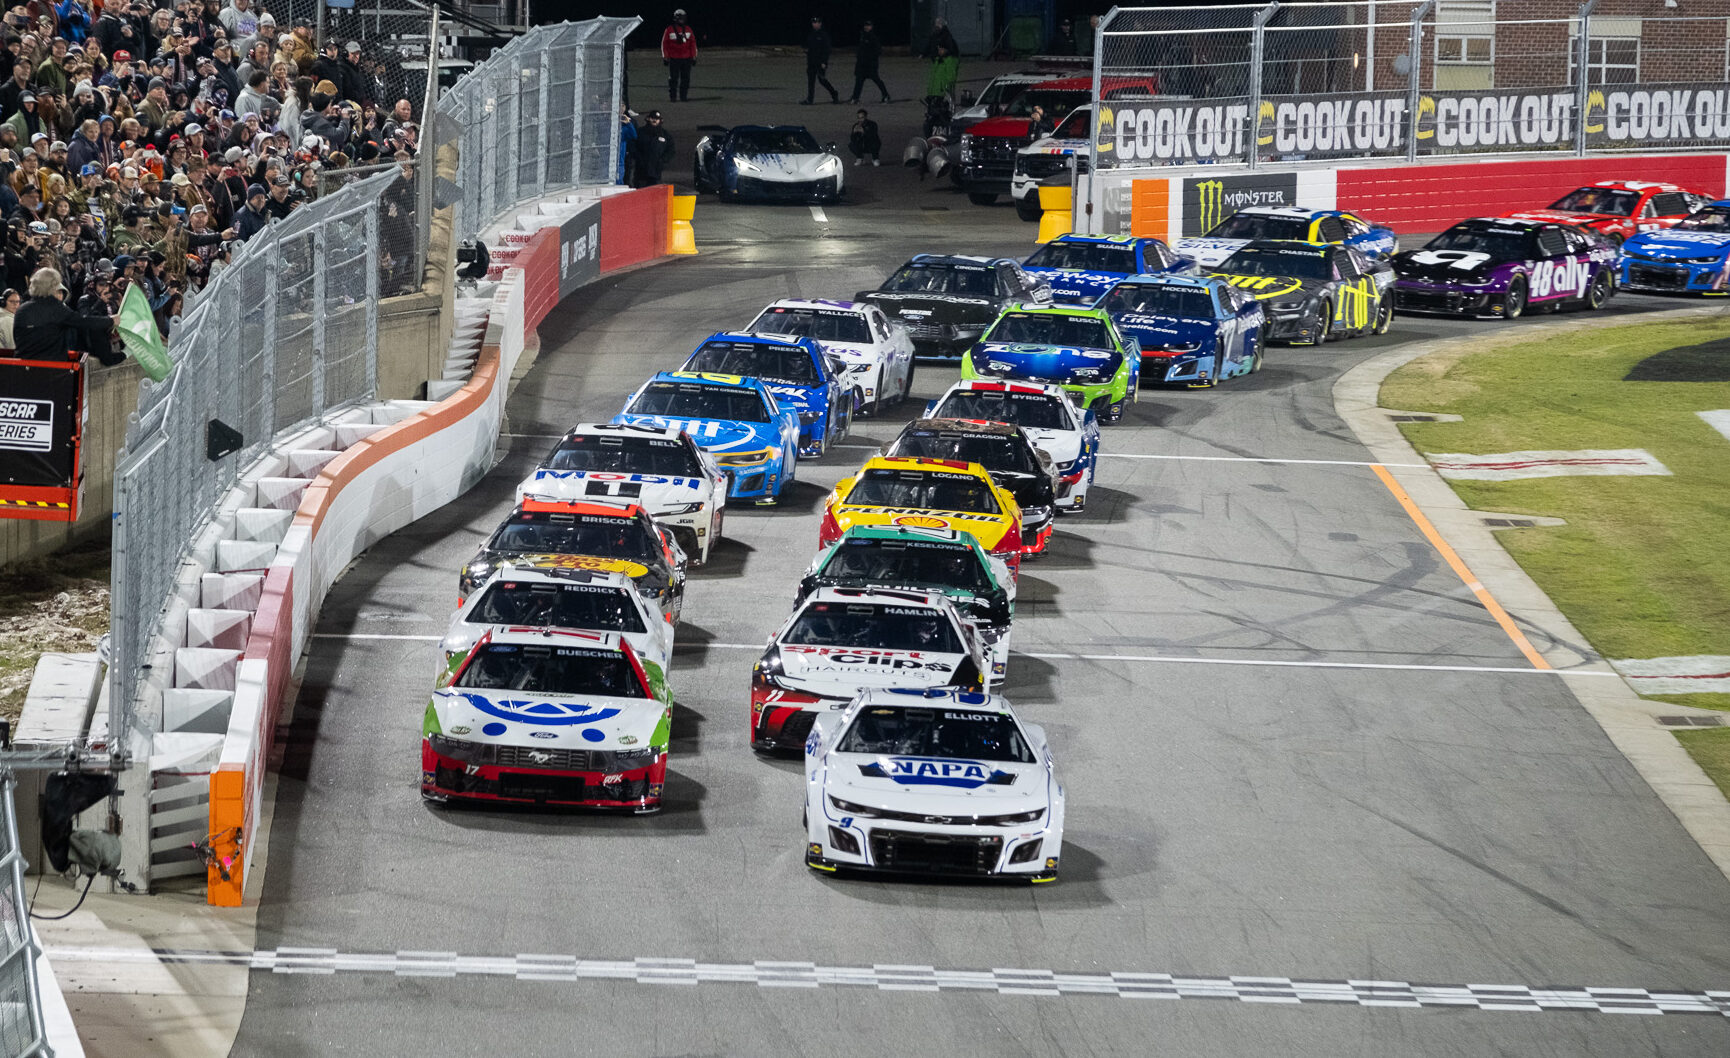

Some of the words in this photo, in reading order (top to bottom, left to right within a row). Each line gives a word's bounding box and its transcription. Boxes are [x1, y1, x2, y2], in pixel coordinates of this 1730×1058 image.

[1437, 94, 1518, 147] COOK
[1520, 92, 1575, 144] OUT
[1607, 89, 1691, 140] COOK
[1276, 99, 1353, 152] COOK
[1354, 97, 1406, 149] OUT
[1116, 106, 1194, 160] COOK
[1195, 104, 1249, 157] OUT
[1530, 260, 1554, 298] 48
[1554, 256, 1591, 299] ally
[1068, 317, 1102, 325] BUSCH
[768, 345, 802, 353] PREECE
[1011, 394, 1048, 402] BYRON
[962, 433, 1008, 441] GRAGSON
[649, 440, 678, 448] BELL
[931, 472, 975, 481] LOGANO
[581, 515, 635, 526] BRISCOE
[837, 507, 1005, 524] PENNZOIL
[906, 542, 969, 552] KESELOWSKI
[564, 585, 618, 595] REDDICK
[884, 606, 938, 618] HAMLIN
[557, 649, 624, 660] BUESCHER
[765, 690, 785, 702] 11
[943, 711, 1001, 723] ELLIOTT
[465, 764, 480, 776] 17
[891, 761, 987, 779] NAPA
[838, 817, 854, 828] 9
